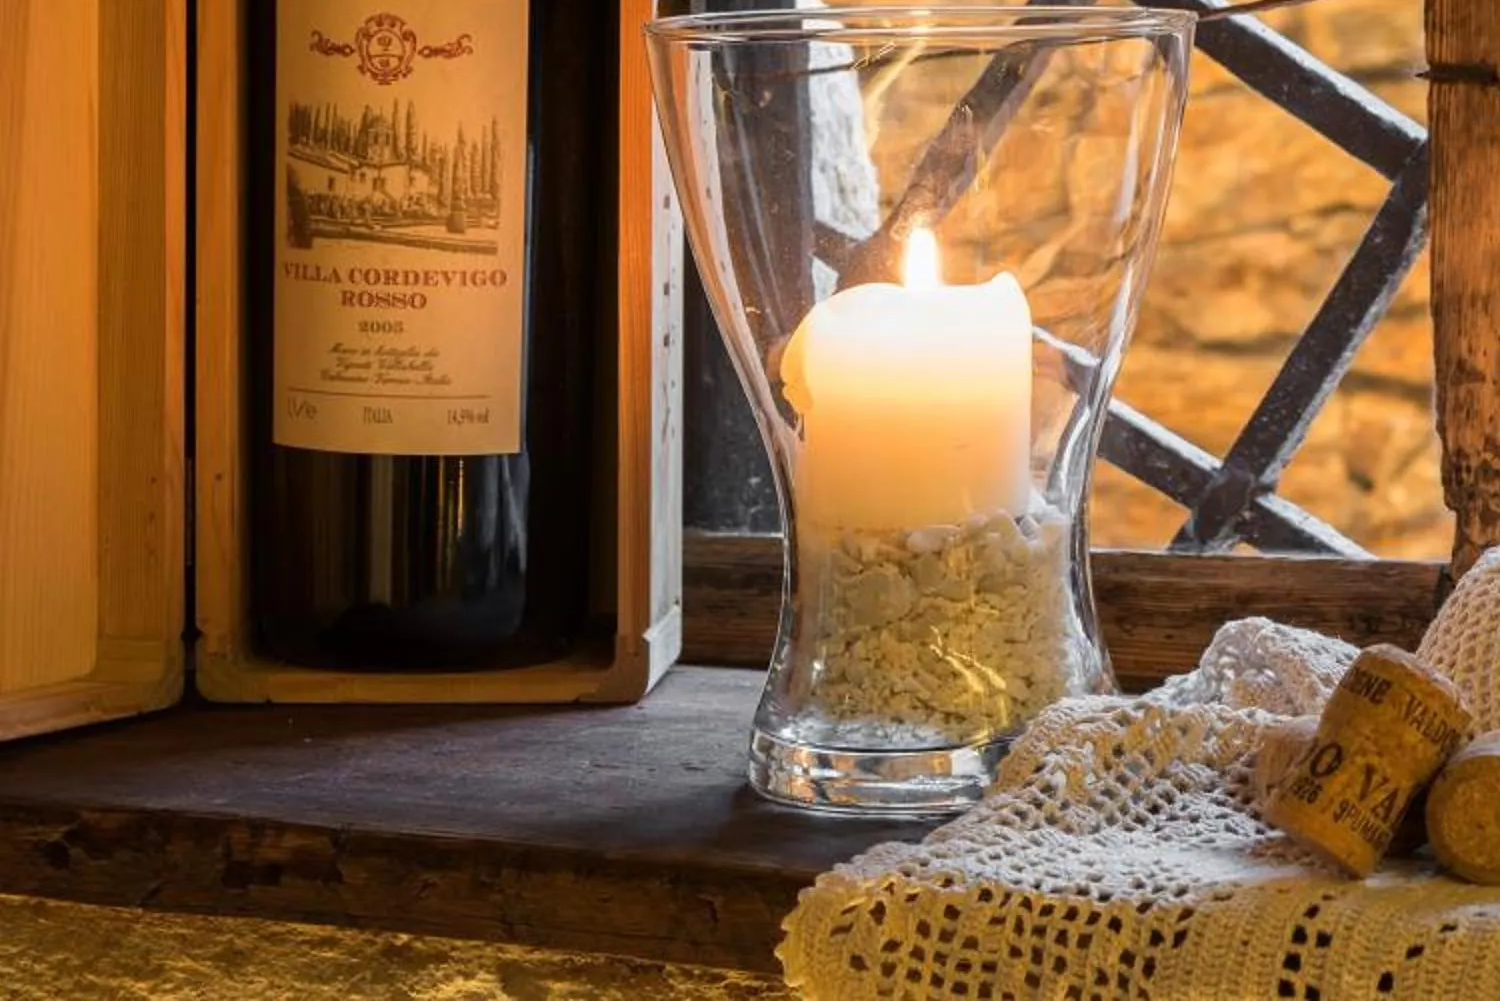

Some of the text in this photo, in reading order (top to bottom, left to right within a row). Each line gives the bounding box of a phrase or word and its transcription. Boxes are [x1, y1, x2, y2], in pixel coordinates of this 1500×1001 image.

[284, 261, 507, 287] VILLA CORDEVIGO
[340, 289, 428, 309] ROSSO
